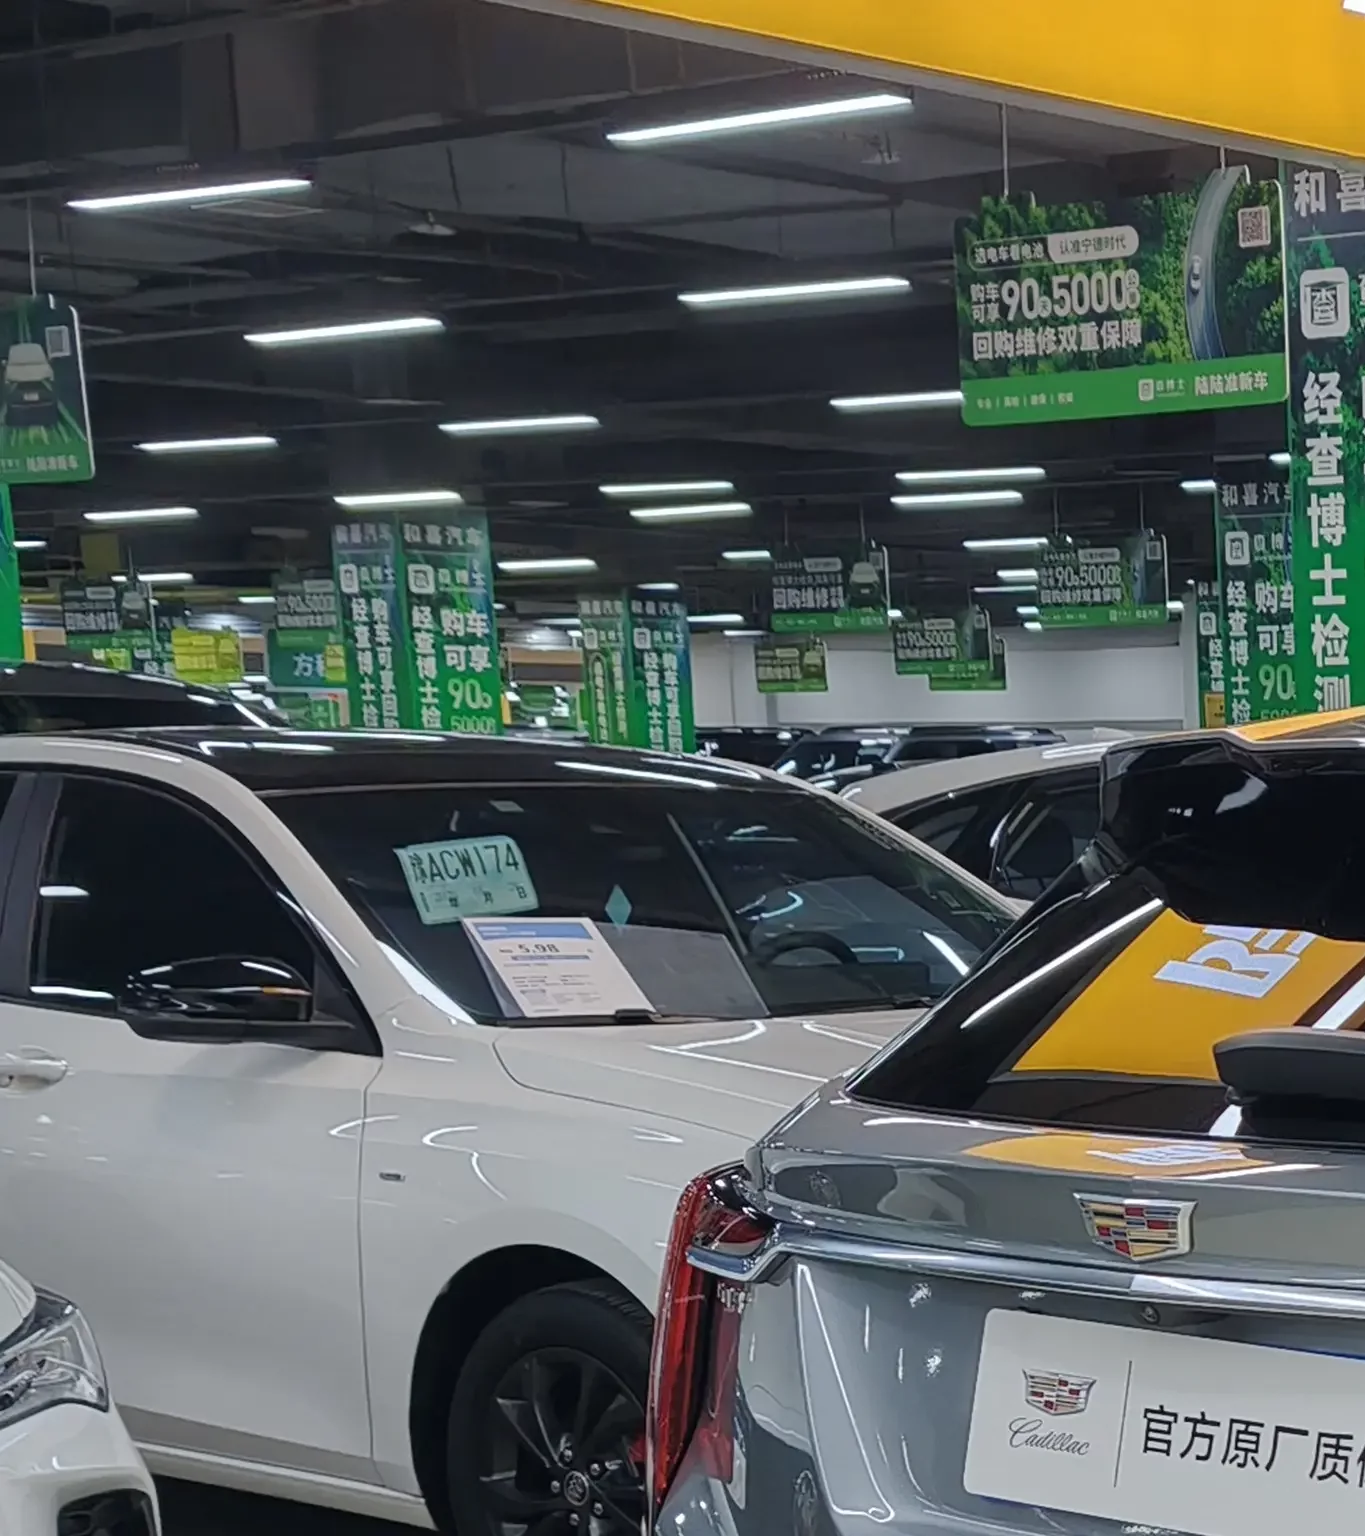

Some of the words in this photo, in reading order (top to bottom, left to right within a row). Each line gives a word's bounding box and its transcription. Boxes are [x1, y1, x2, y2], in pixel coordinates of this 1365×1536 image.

[1059, 232, 1128, 256] 认准宁德时代
[971, 318, 1142, 362] 回购维修双重保障
[1303, 370, 1351, 714] 经查博士检测
[440, 607, 490, 638] 购车
[443, 644, 492, 673] 可享
[1226, 580, 1251, 725] 经查博士检
[1008, 1416, 1091, 1457] Cadillac
